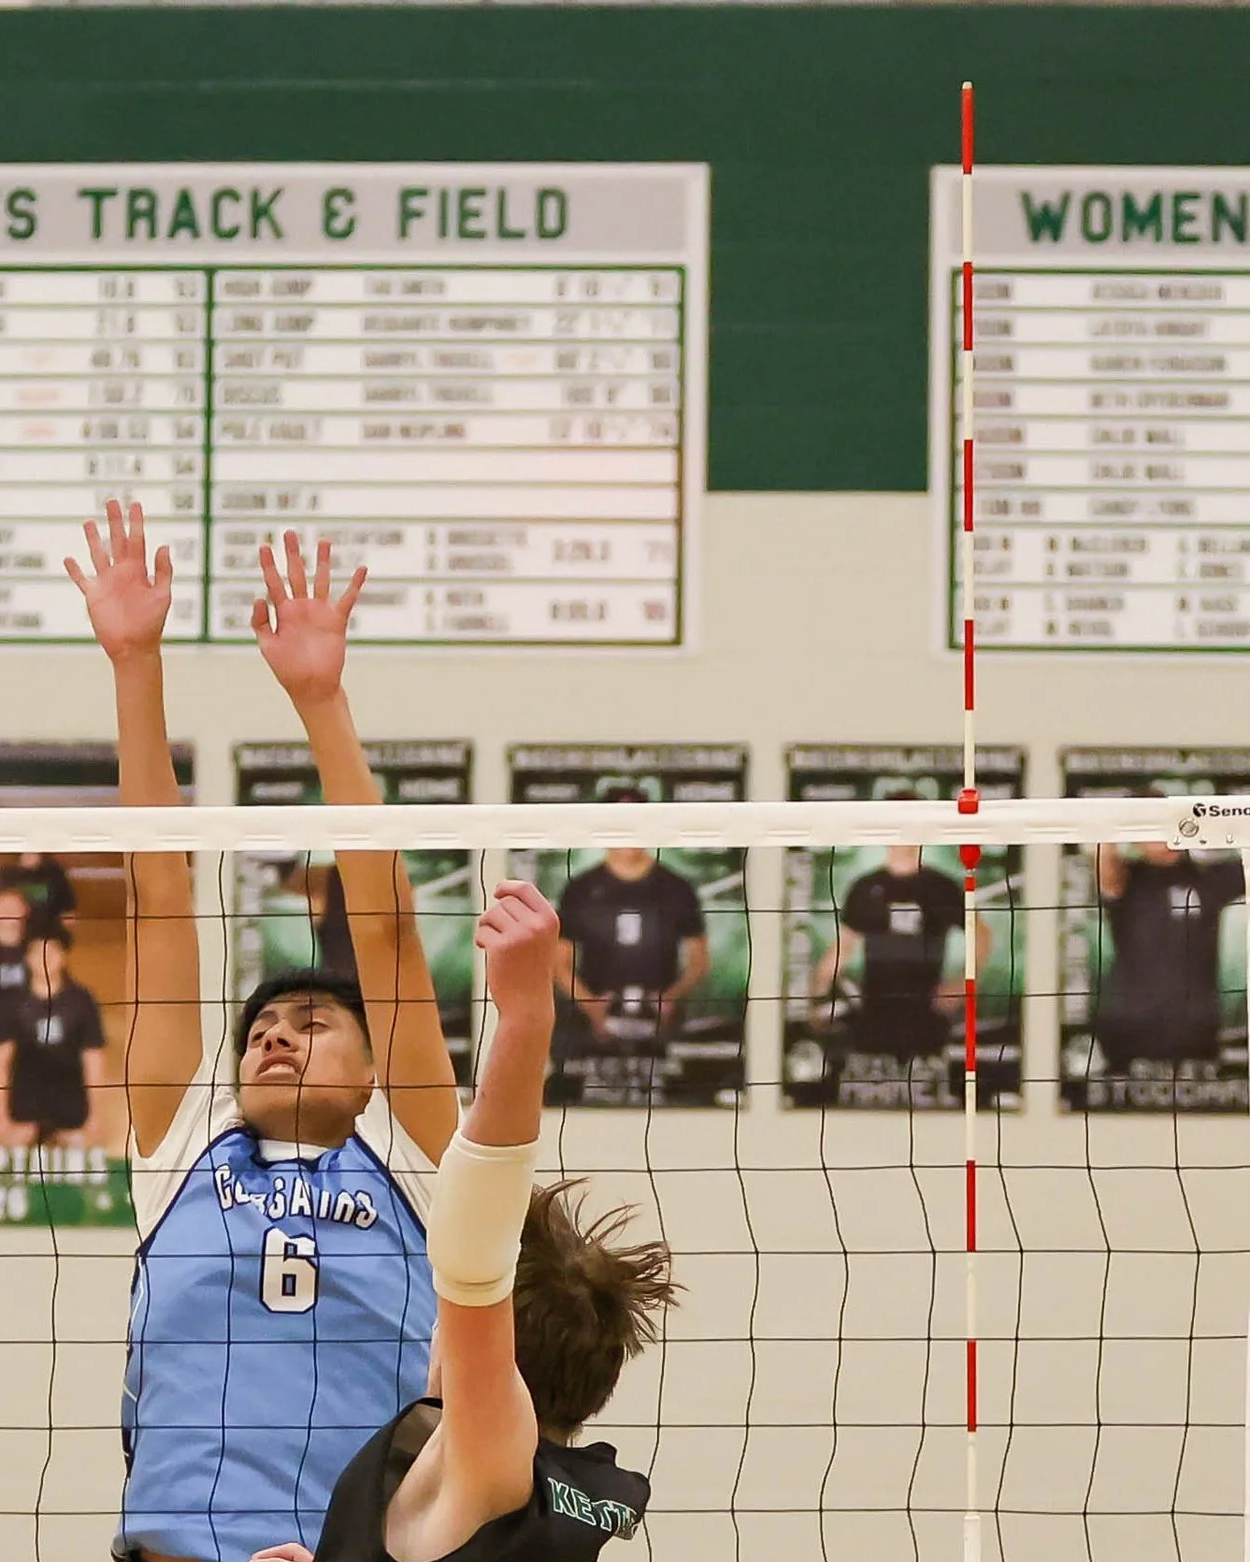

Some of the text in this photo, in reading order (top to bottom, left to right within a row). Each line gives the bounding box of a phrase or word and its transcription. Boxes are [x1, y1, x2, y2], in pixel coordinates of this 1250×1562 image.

[78, 187, 286, 240] TRACK
[321, 187, 357, 239] &
[397, 186, 569, 239] FIELD
[1020, 190, 1248, 244] WOMEN
[260, 1226, 319, 1315] 6
